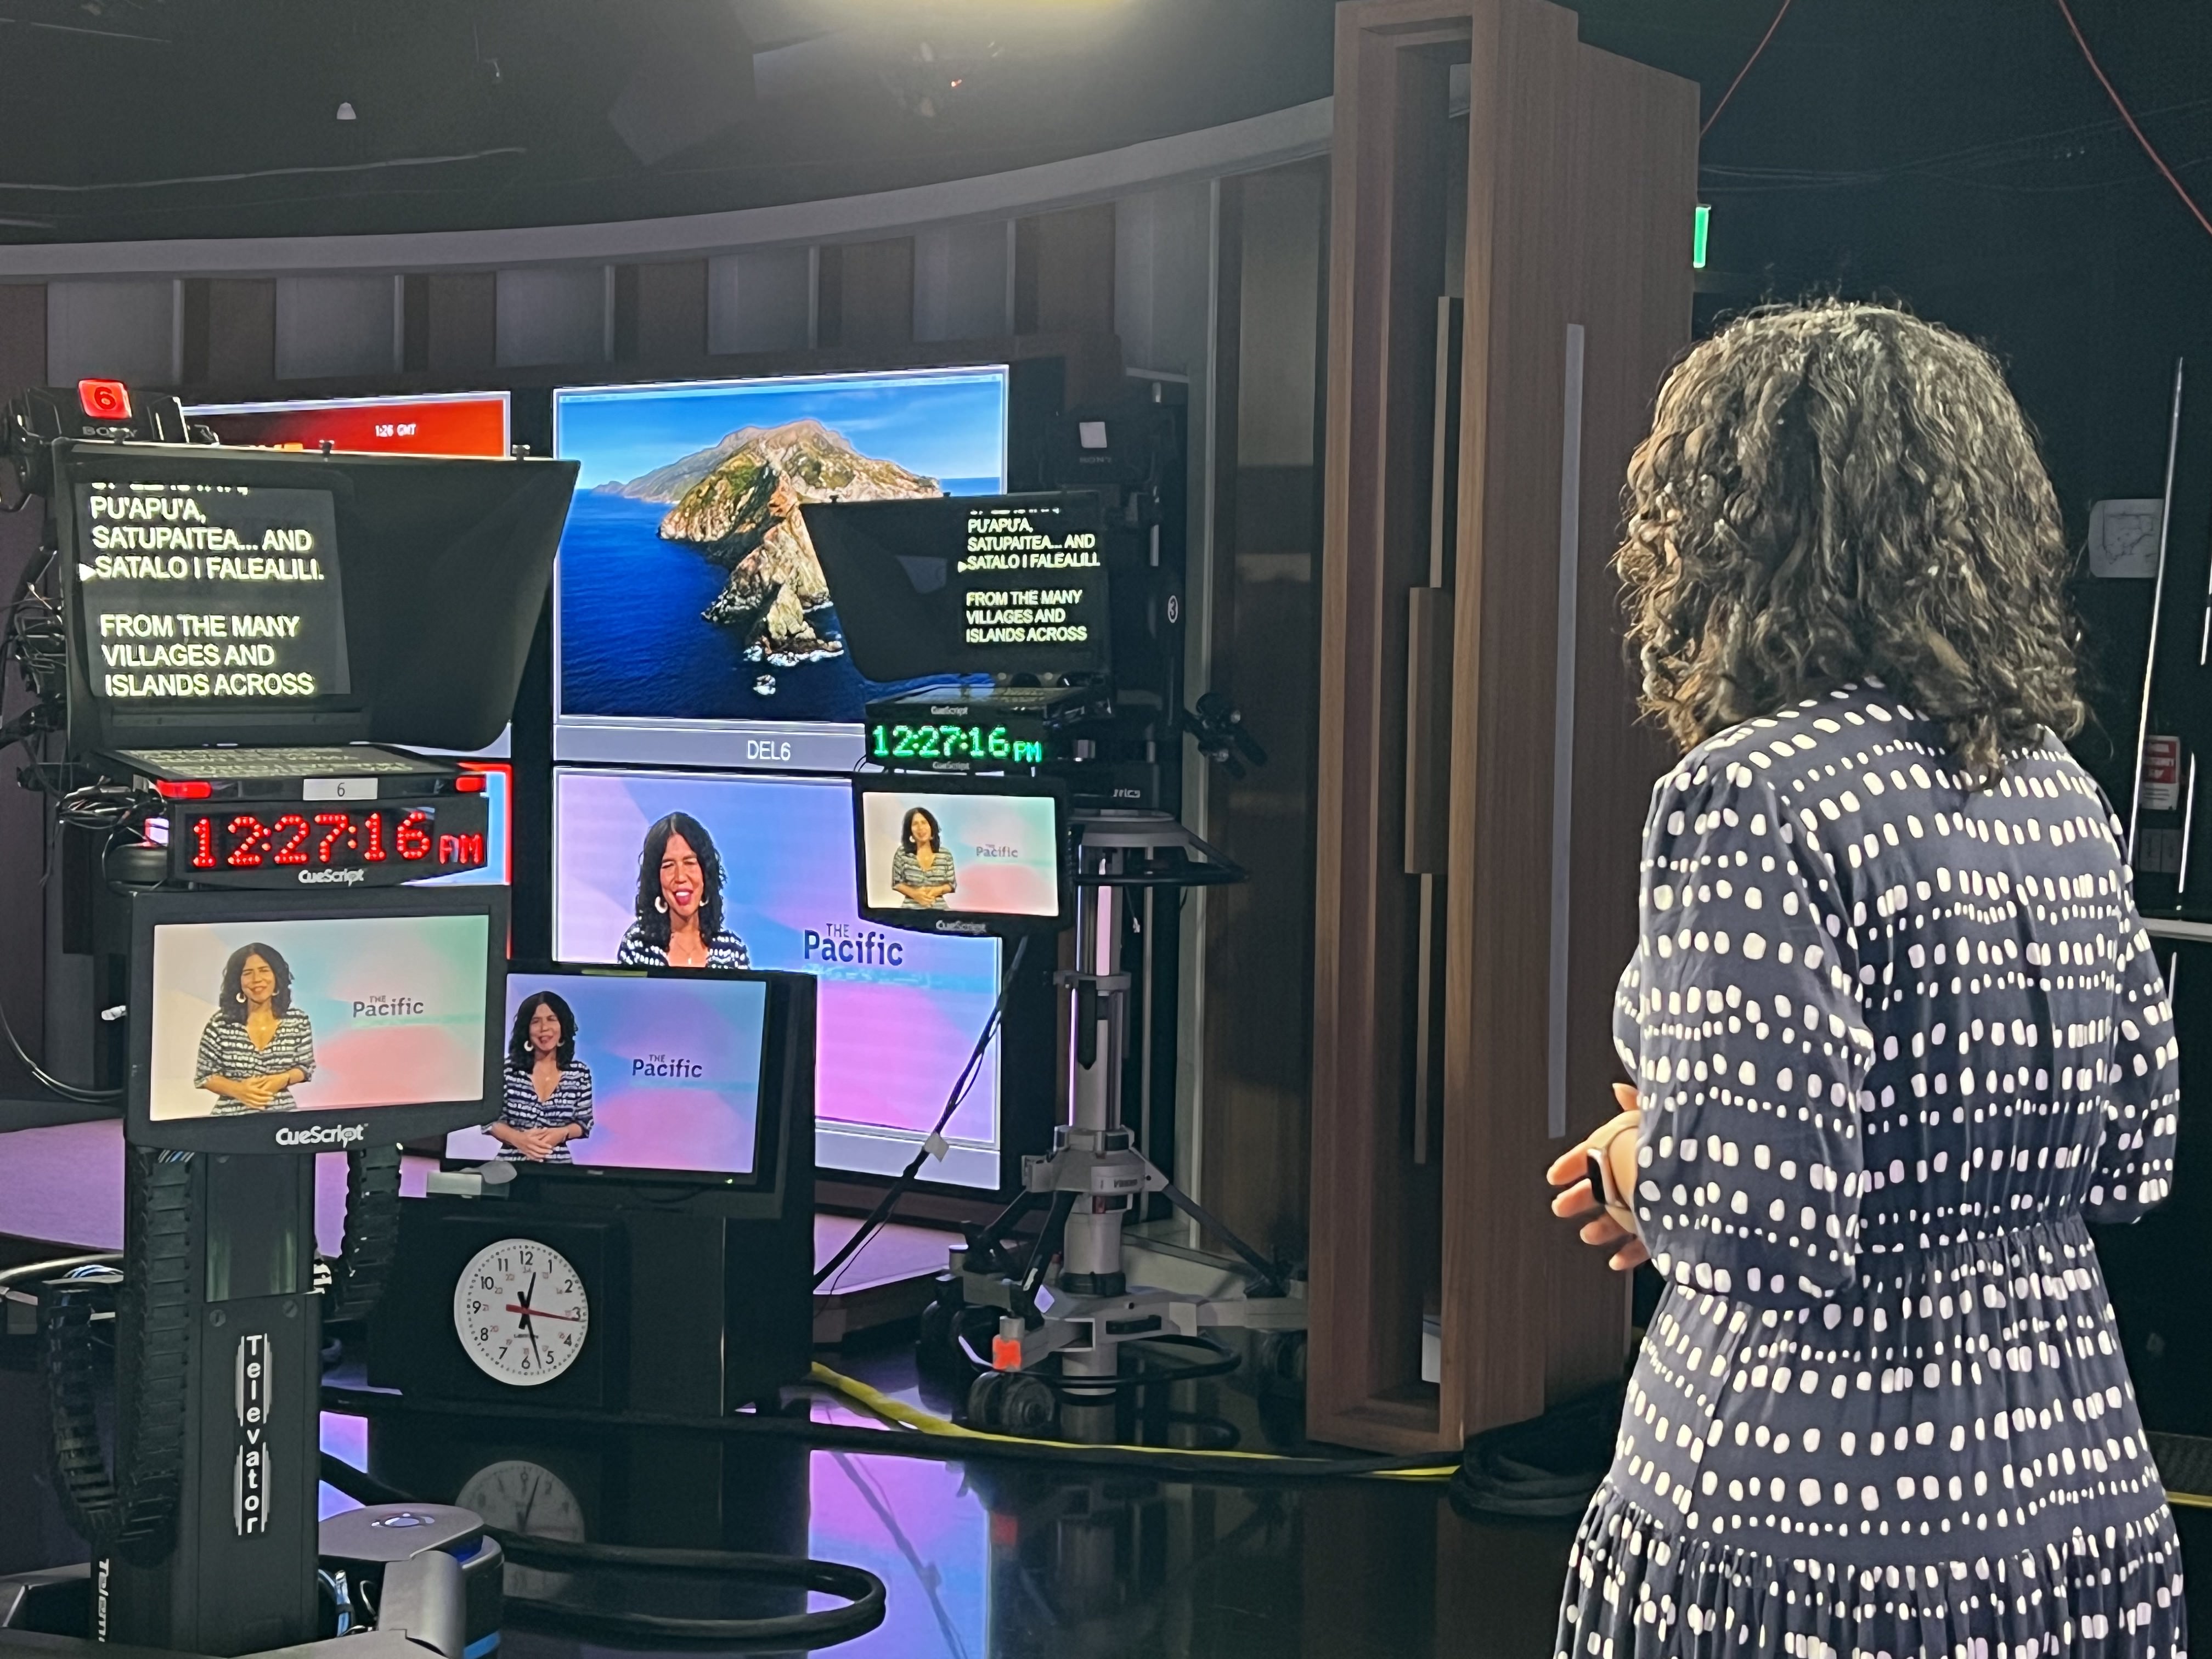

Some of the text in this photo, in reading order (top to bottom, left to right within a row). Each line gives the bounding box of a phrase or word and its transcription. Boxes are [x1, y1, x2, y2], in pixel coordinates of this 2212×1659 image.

[94, 386, 116, 410] 6
[90, 495, 206, 524] PU'APU'A,
[92, 525, 313, 551] SATUPAITEA... AND
[1064, 534, 1096, 549] AND
[94, 555, 325, 580] SATALO I FALEALILI.
[967, 554, 1020, 571] SATALO
[966, 589, 1083, 606] FROM THE MANY
[966, 608, 1066, 624] VILLAGES AND
[100, 614, 300, 638] FROM THE MANY
[966, 625, 1088, 643] ISLANDS ACROSS
[101, 643, 275, 667] VILLAGES AND
[105, 672, 315, 697] ISLANDS ACROSS
[747, 740, 791, 761] DEL6
[872, 724, 1043, 763] 12:27:16 PM
[337, 782, 346, 797] 6
[192, 811, 431, 868] 12:27:16
[298, 868, 364, 887] CueScript
[826, 923, 850, 938] THE
[804, 929, 903, 966] Pacific
[353, 997, 424, 1018] Pacific
[648, 1054, 665, 1063] THE
[632, 1058, 703, 1078] Pacific
[275, 1124, 364, 1149] CueScript
[498, 1257, 509, 1272] 11
[520, 1250, 533, 1266] 12
[548, 1259, 552, 1274] 1
[481, 1276, 494, 1290] 10
[564, 1279, 573, 1294] 2
[472, 1300, 481, 1314] 9
[480, 1327, 489, 1341] 8
[563, 1333, 572, 1347] 4
[498, 1346, 508, 1360] 7
[545, 1350, 555, 1364] 5
[521, 1355, 531, 1370] 6
[244, 1334, 262, 1534] Televator
